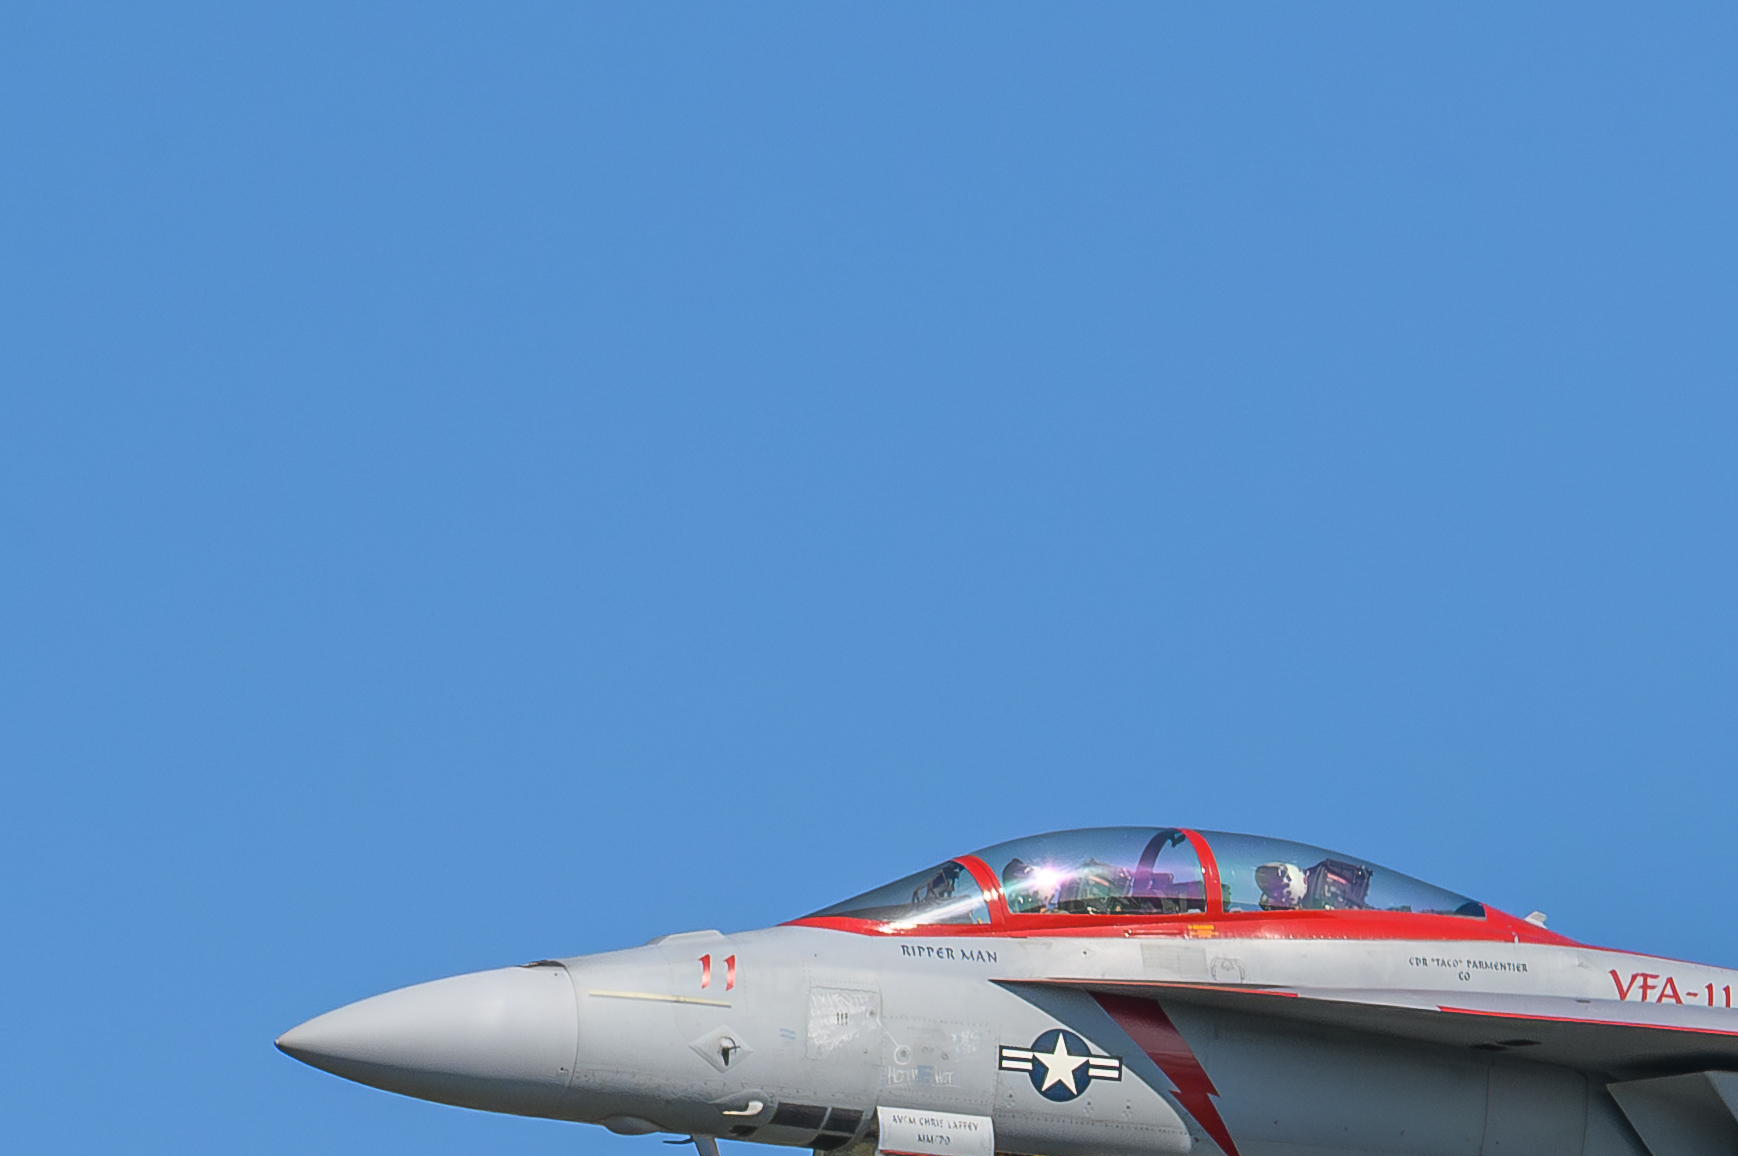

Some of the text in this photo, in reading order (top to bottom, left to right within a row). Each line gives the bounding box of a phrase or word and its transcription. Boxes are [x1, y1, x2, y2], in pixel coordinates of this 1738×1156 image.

[900, 944, 998, 964] RIPPER MAN
[1408, 956, 1428, 968] CDR
[698, 953, 736, 992] 11
[1457, 970, 1471, 982] CO
[1608, 968, 1732, 1008] VFA-11
